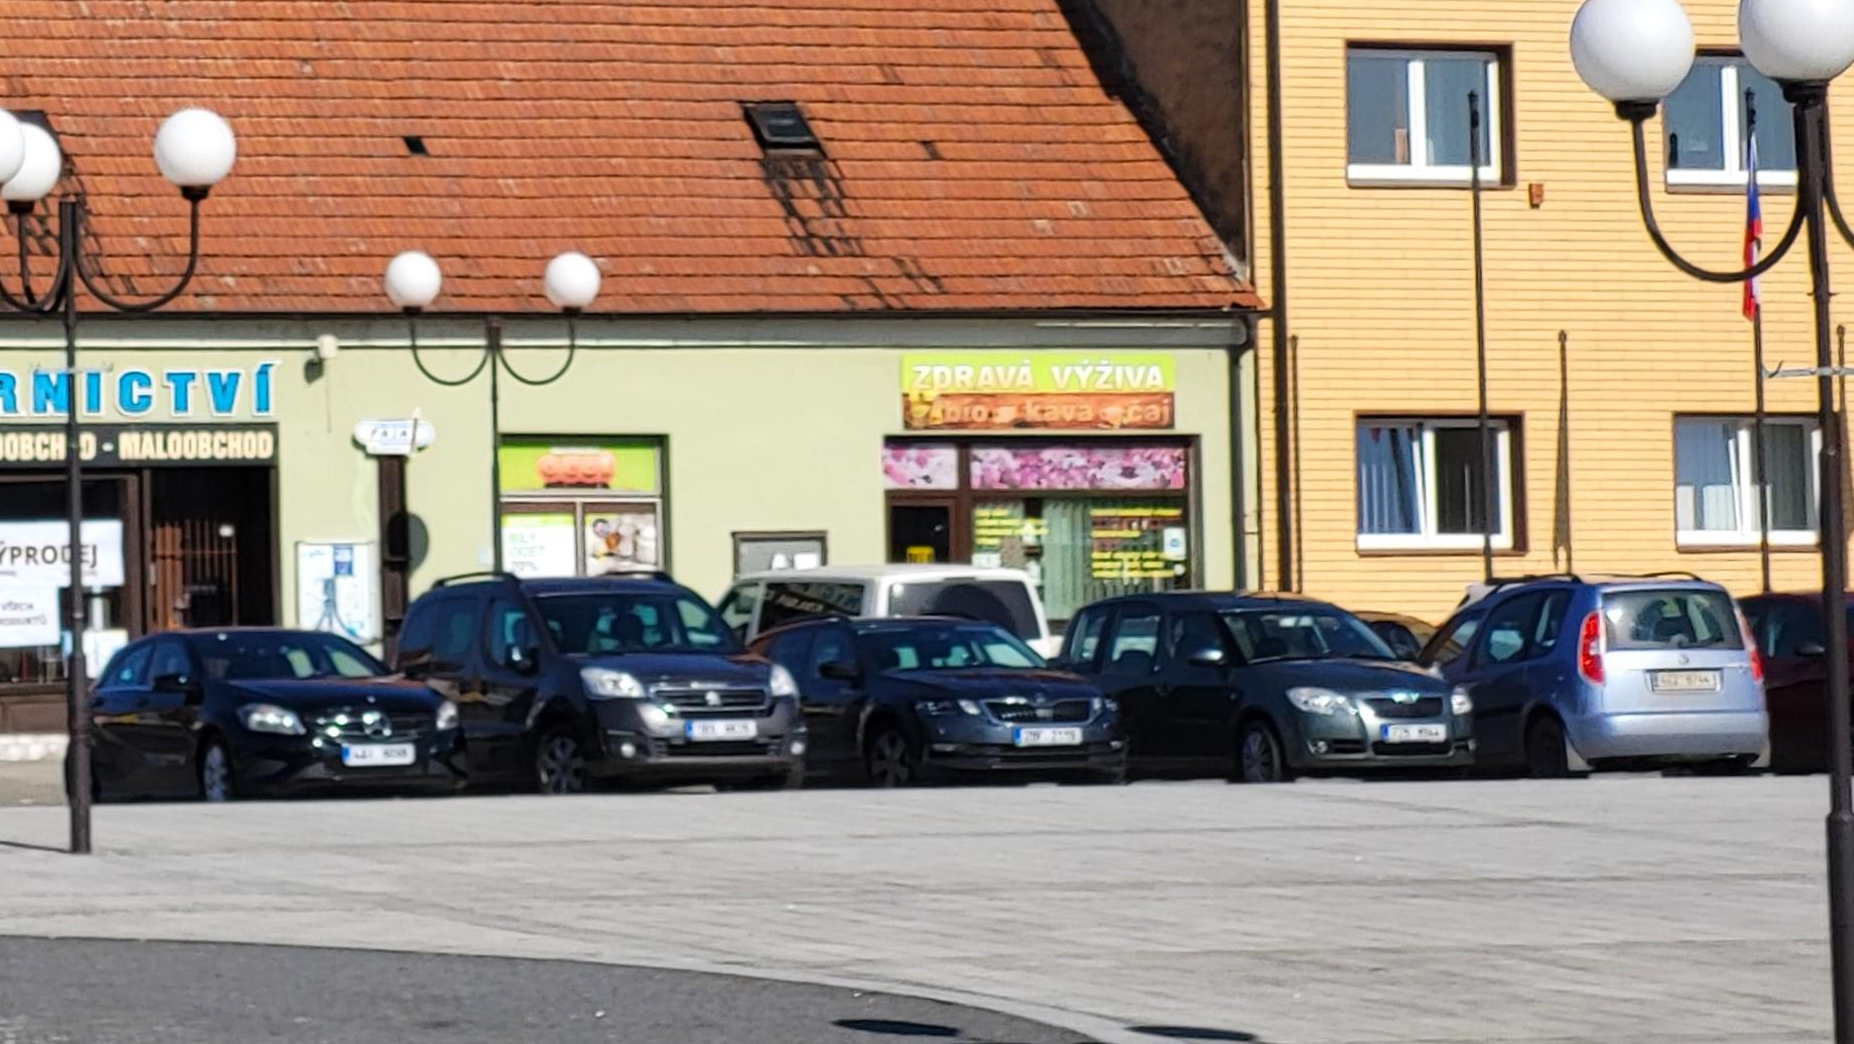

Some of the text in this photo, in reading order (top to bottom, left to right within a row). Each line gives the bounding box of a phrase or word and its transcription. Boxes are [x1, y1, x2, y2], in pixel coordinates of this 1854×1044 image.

[912, 359, 1164, 390] ZDRAVÁ VÝŽIVA
[118, 431, 273, 461] MALOOBCHOD
